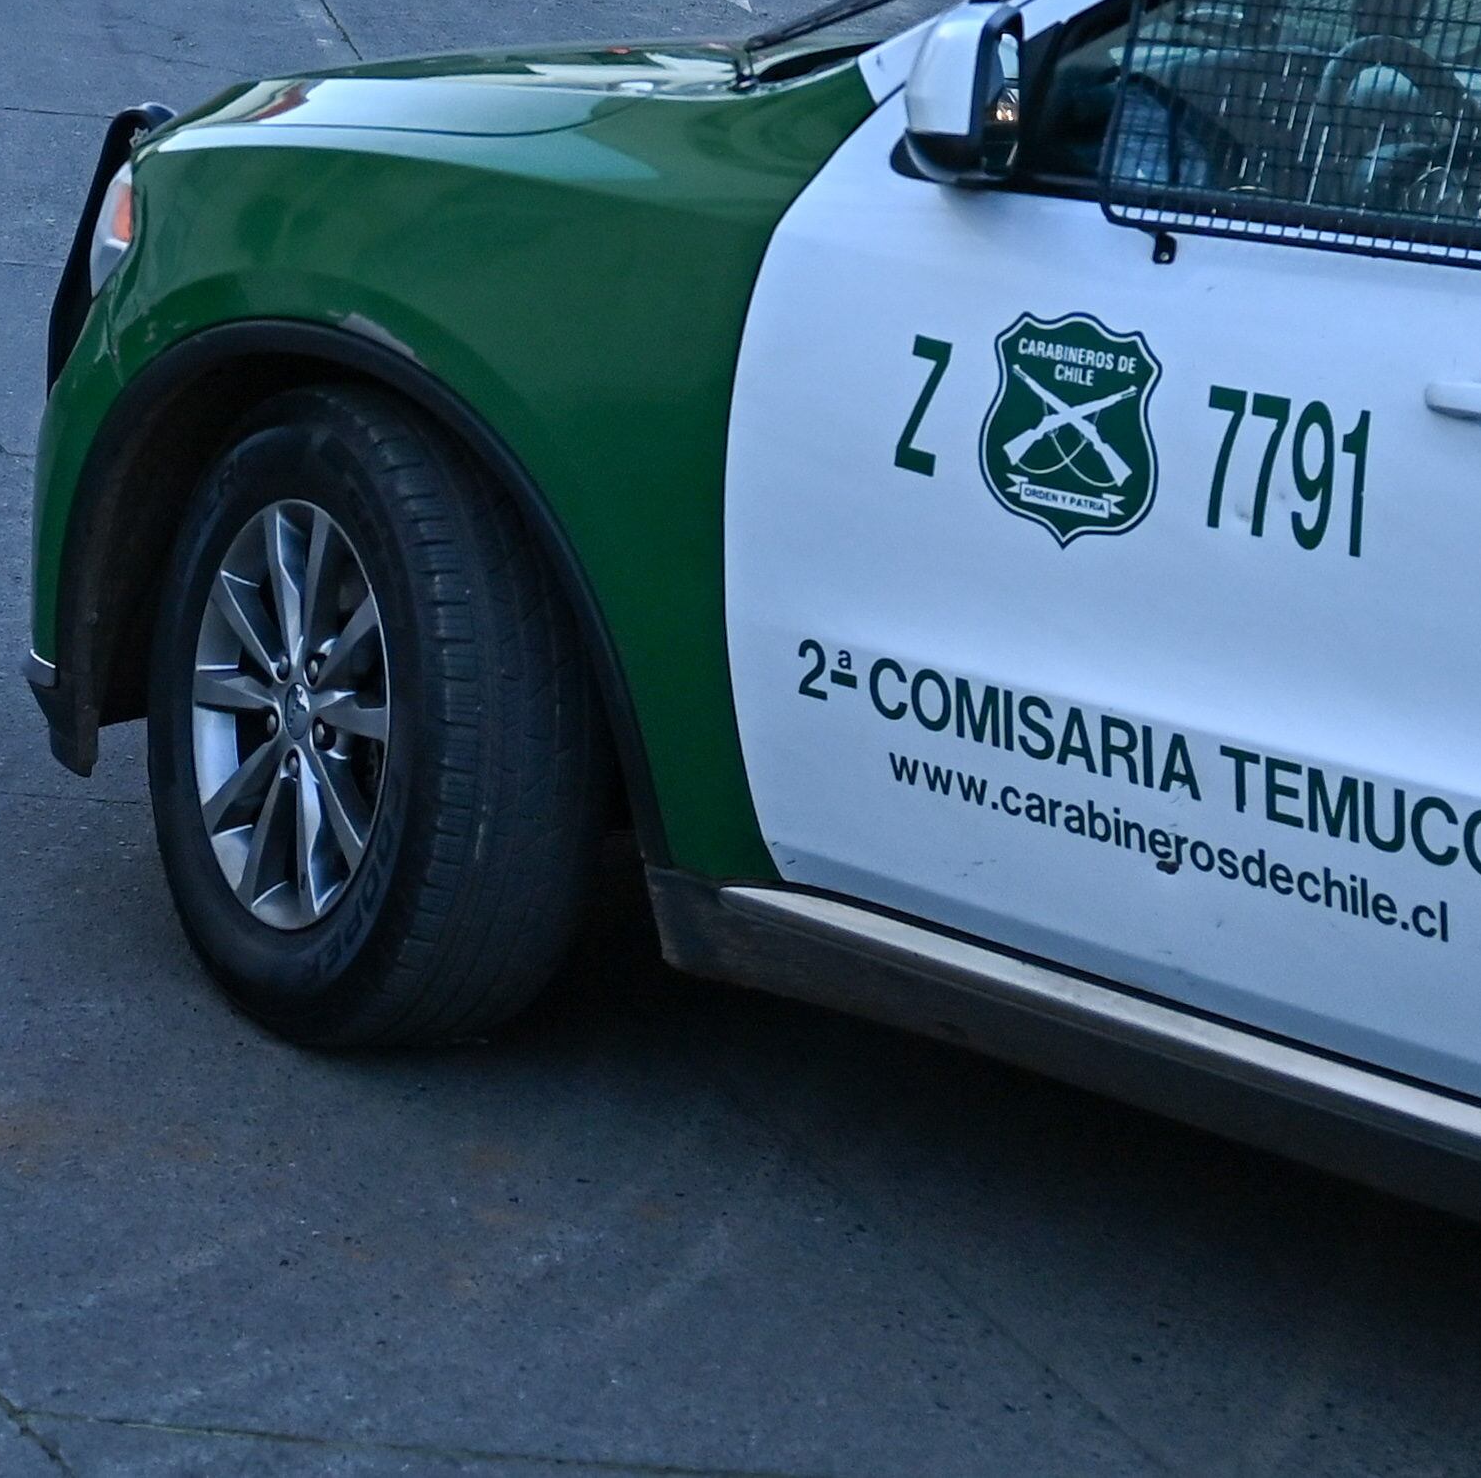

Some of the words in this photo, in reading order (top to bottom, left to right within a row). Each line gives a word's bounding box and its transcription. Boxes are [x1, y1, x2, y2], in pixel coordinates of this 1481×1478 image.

[1018, 337, 1115, 370] CARABINEROS
[1117, 356, 1138, 375] DE
[1054, 363, 1095, 387] CHILE
[894, 333, 953, 477] Z
[1207, 385, 1371, 558] 7791
[1024, 487, 1059, 503] ORDEN
[1059, 495, 1067, 504] Y
[1069, 496, 1106, 512] PATRIA
[869, 657, 1202, 802] COMISARIA
[889, 751, 1450, 943] www.carabinerosdechile.cl
